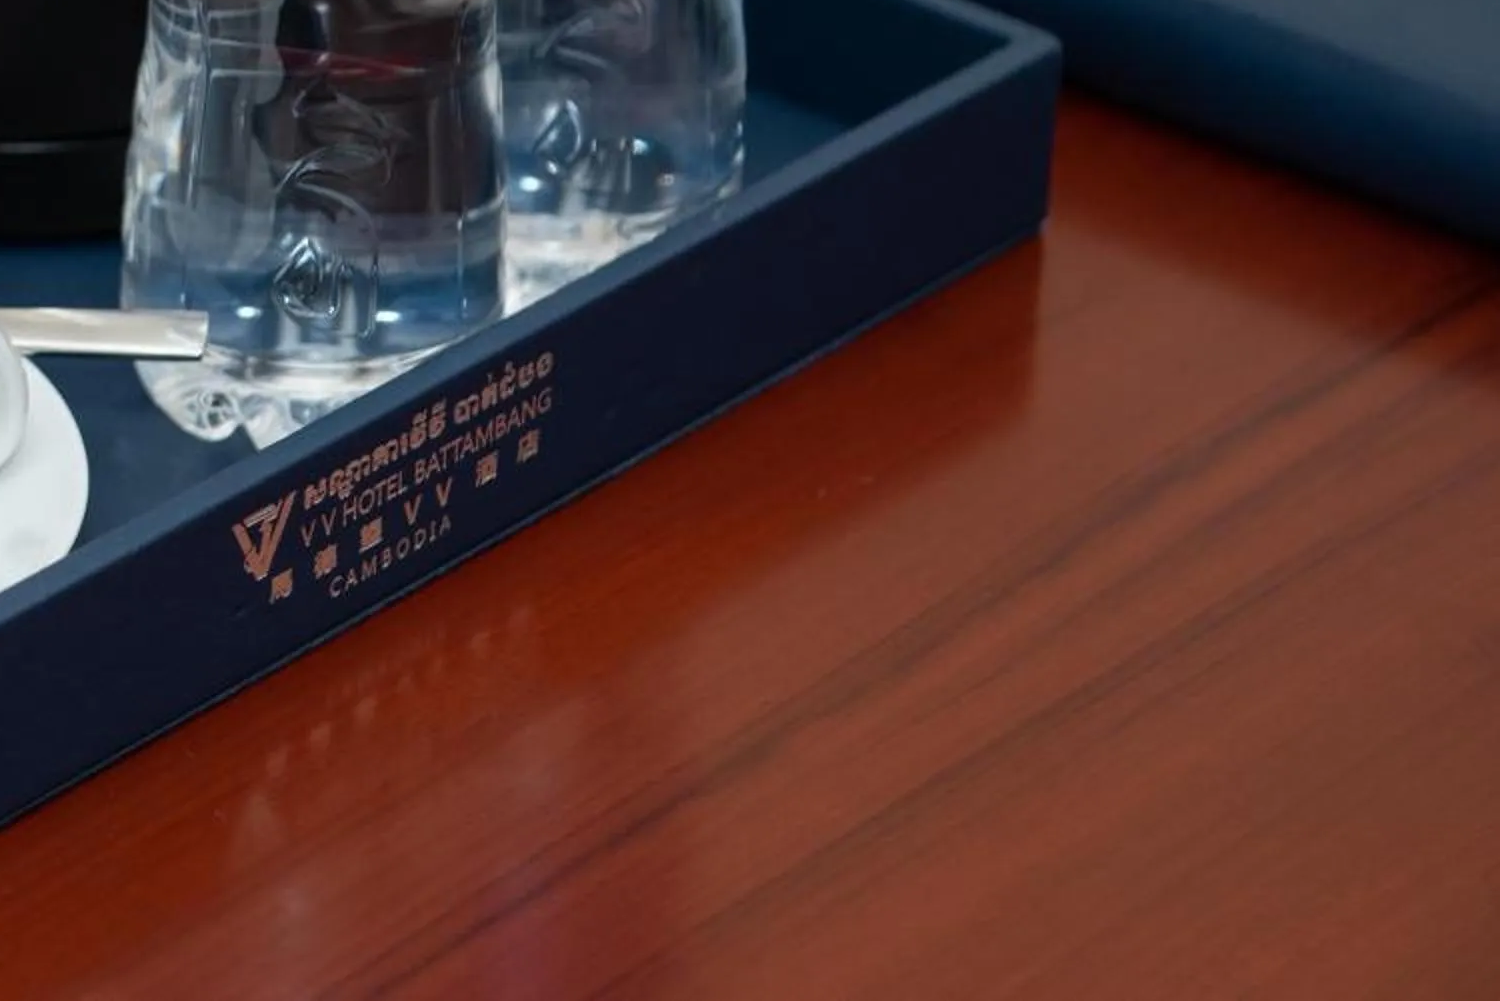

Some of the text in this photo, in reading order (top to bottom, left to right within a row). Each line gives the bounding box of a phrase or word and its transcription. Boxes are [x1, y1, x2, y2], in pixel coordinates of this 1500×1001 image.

[342, 471, 408, 529] HOTEL
[414, 387, 553, 486] BATTAMBANG
[328, 514, 452, 599] CAMBODIA
